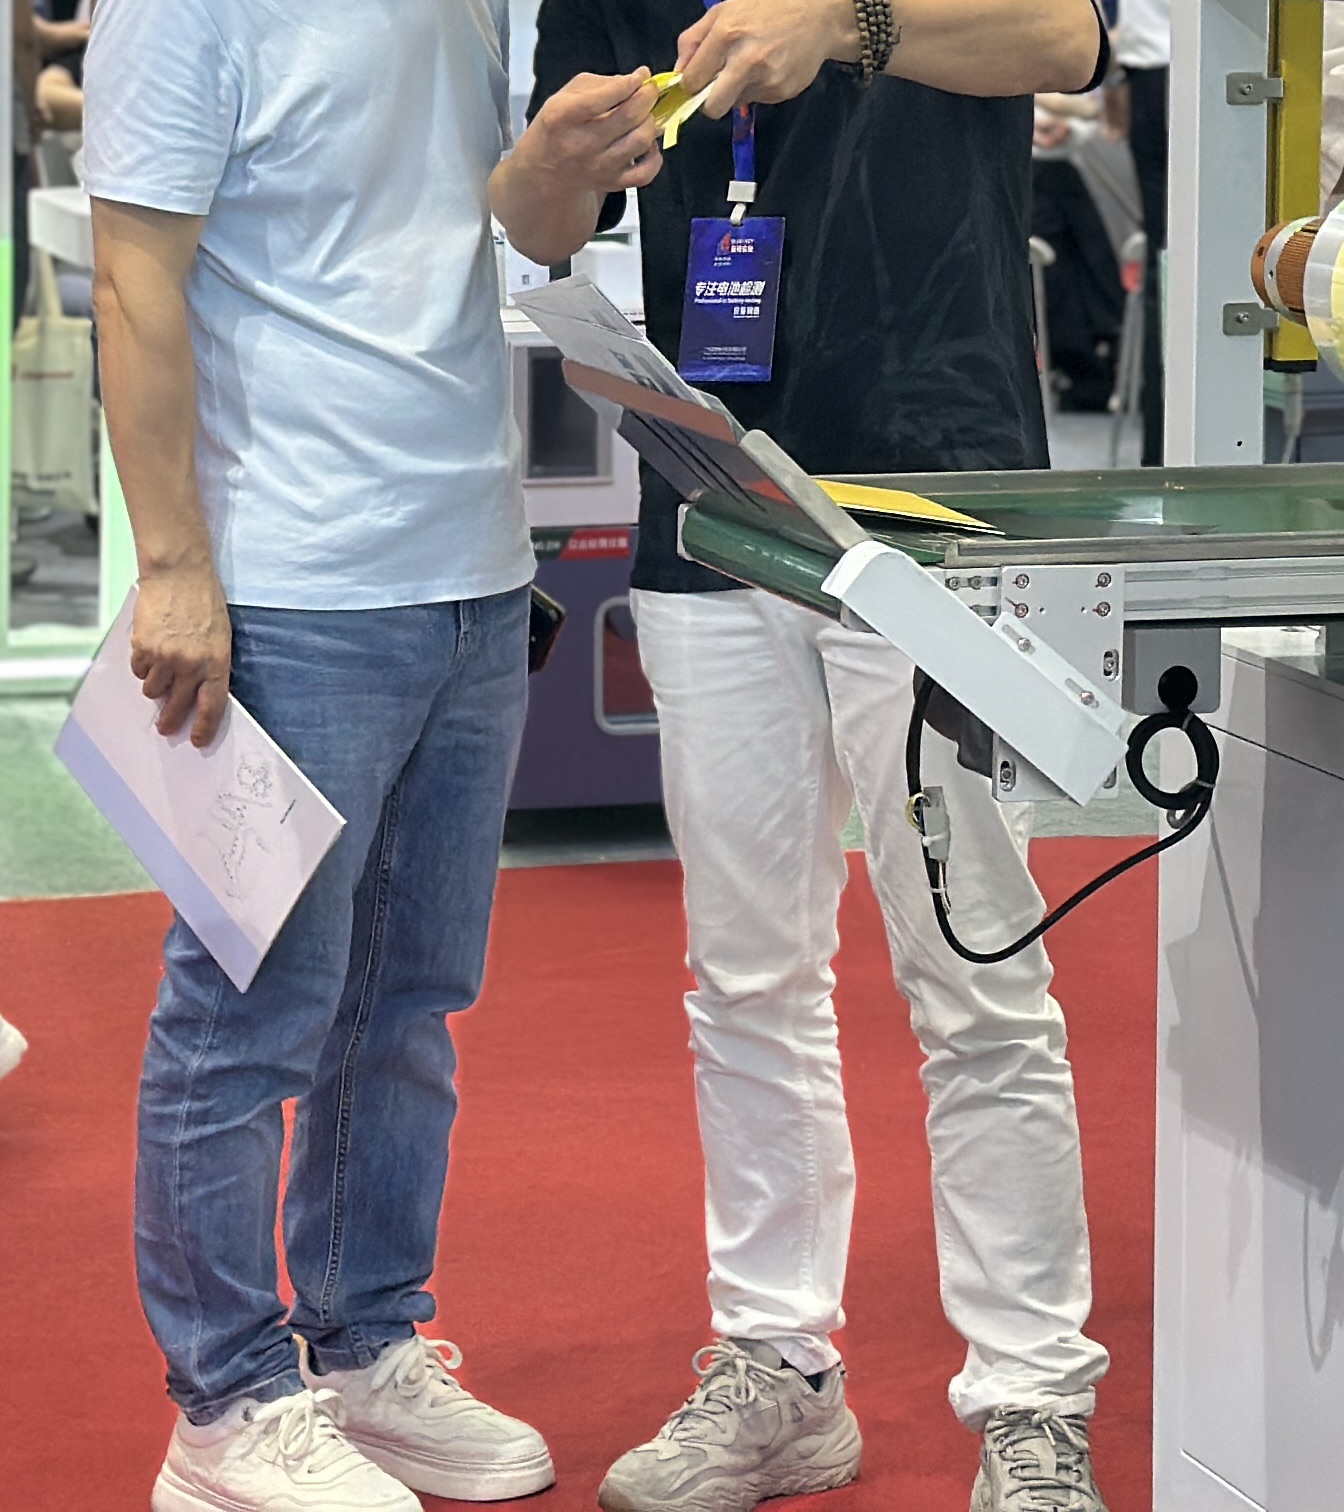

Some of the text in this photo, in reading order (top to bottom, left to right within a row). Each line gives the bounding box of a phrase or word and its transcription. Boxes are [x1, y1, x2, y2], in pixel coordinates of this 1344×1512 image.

[695, 281, 766, 297] 专注电池检测
